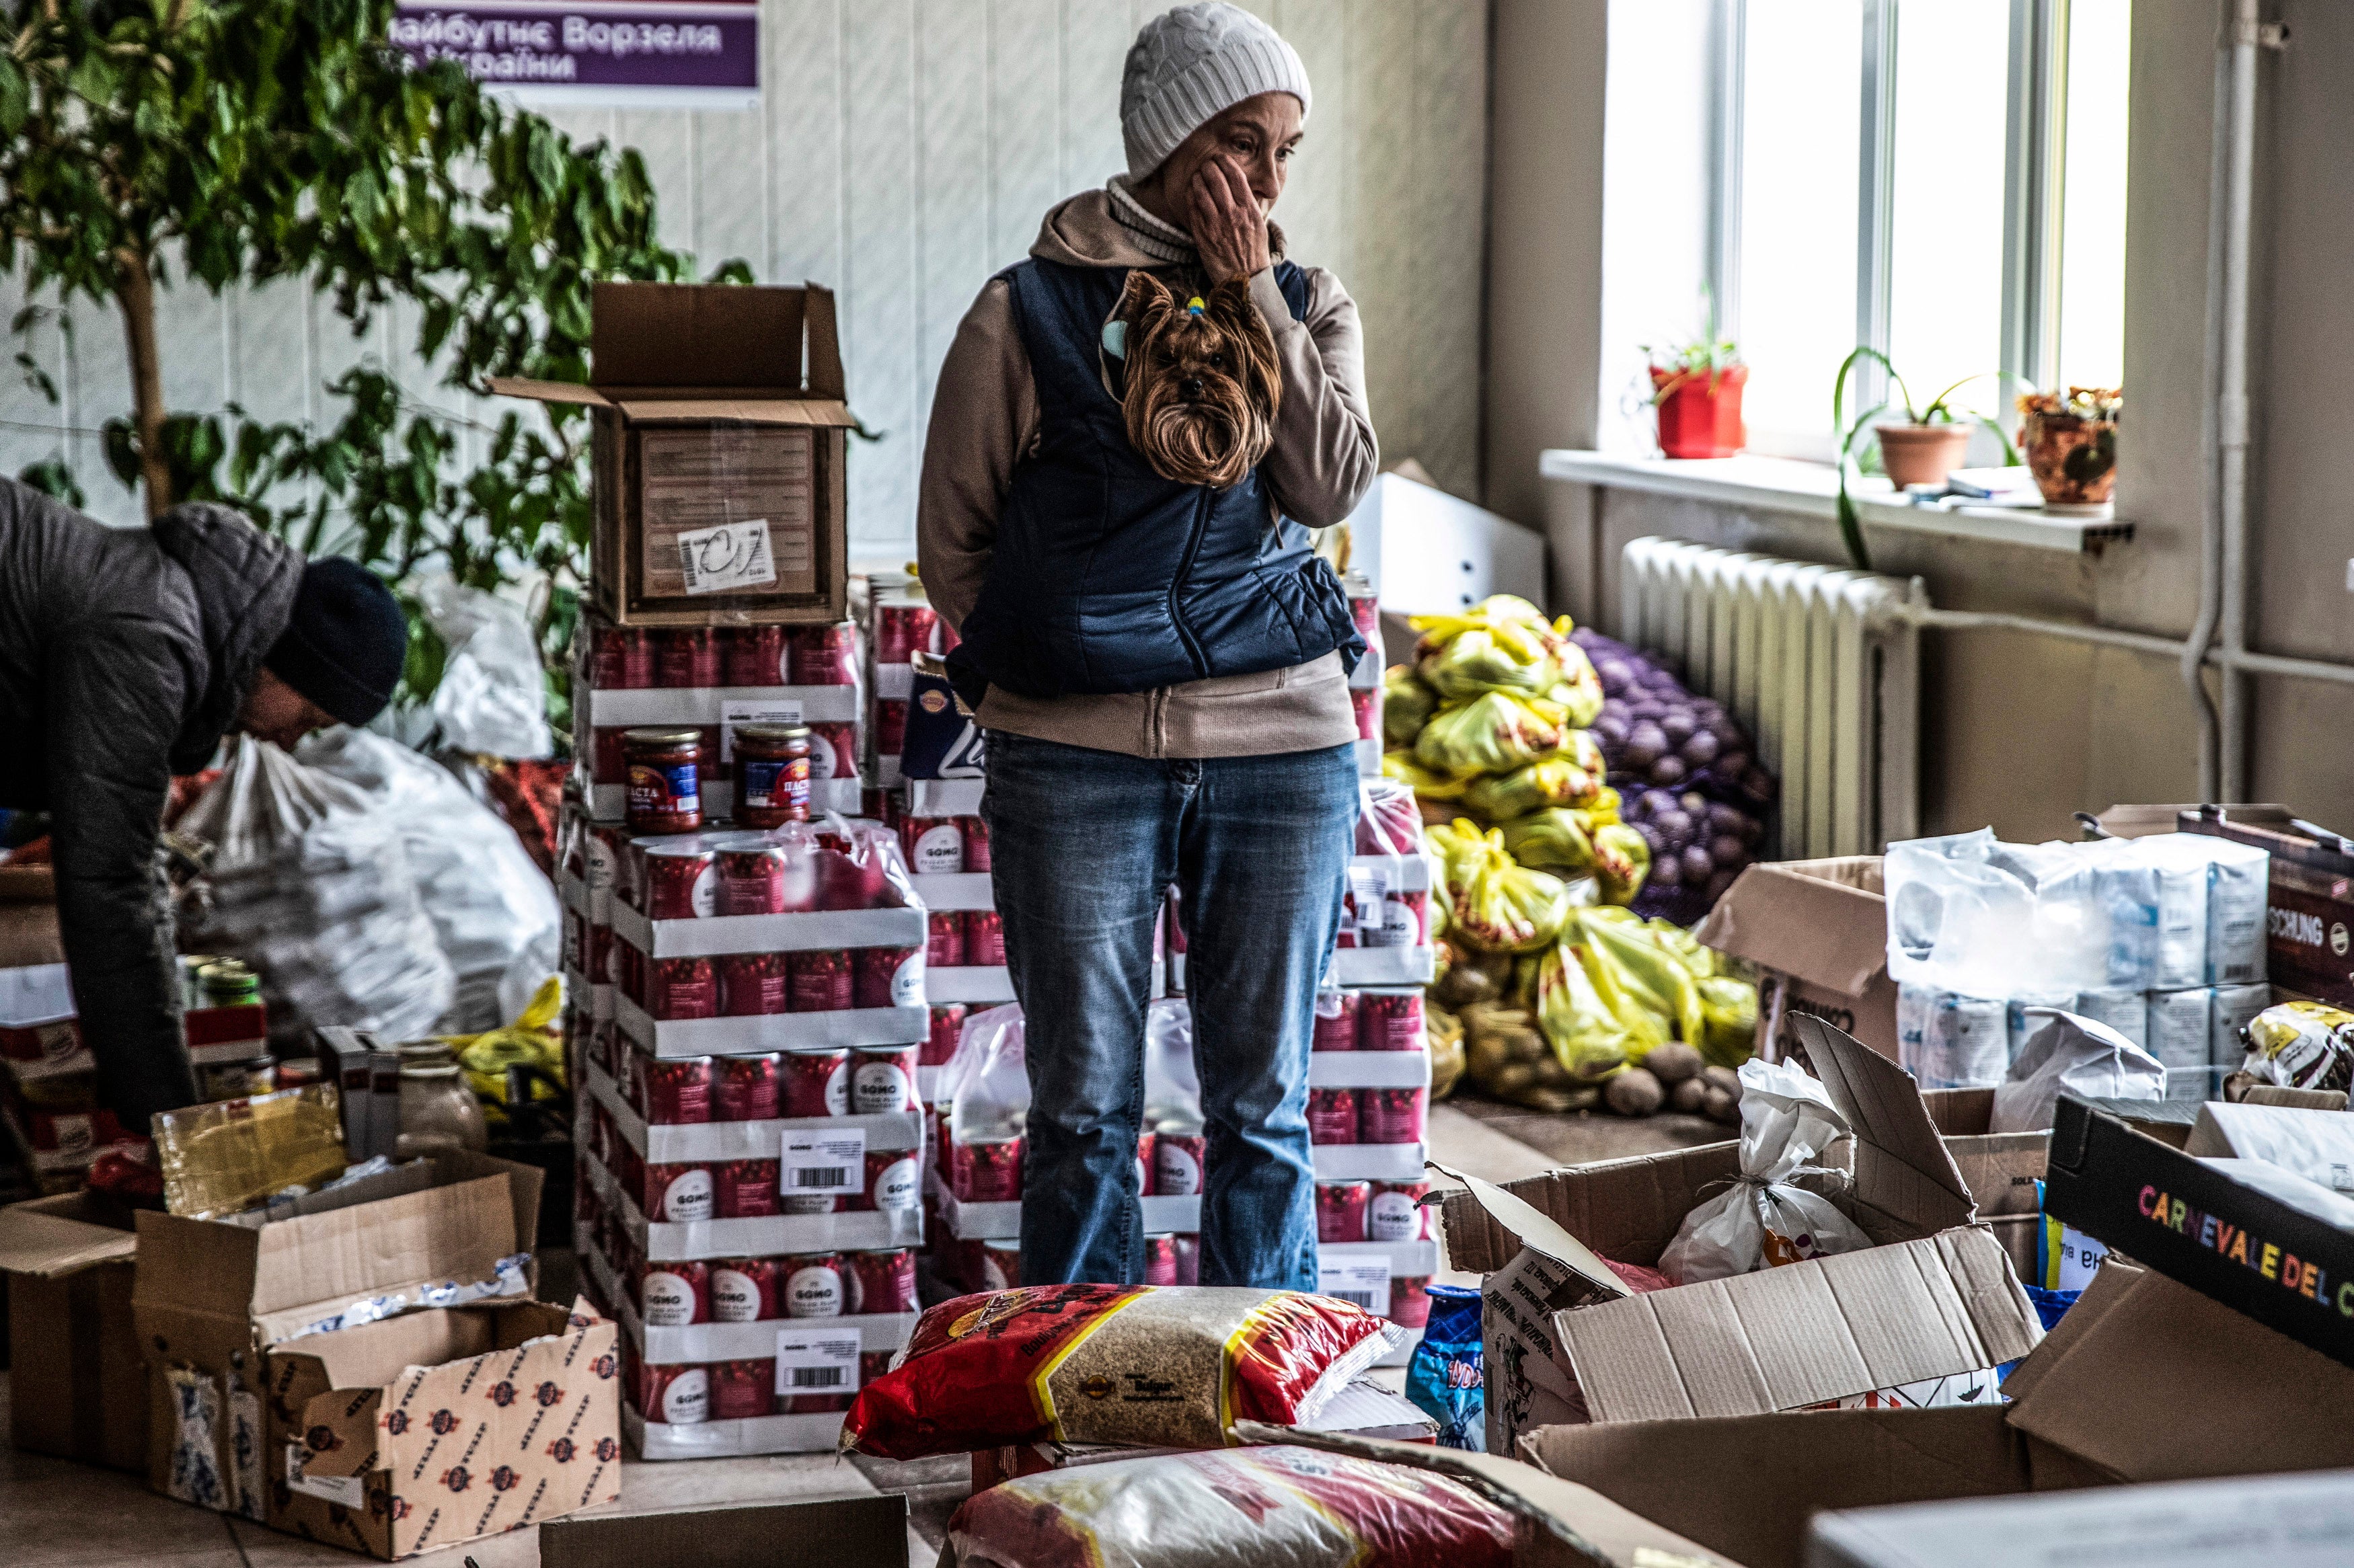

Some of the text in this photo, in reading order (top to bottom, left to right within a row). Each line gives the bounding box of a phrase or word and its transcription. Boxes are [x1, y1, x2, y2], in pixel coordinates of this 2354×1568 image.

[562, 15, 722, 59] Ворзеля
[2139, 1185, 2281, 1280] CARNEVALE
[2282, 1253, 2330, 1306] DEL
[1134, 1379, 1175, 1395] Bulgur
